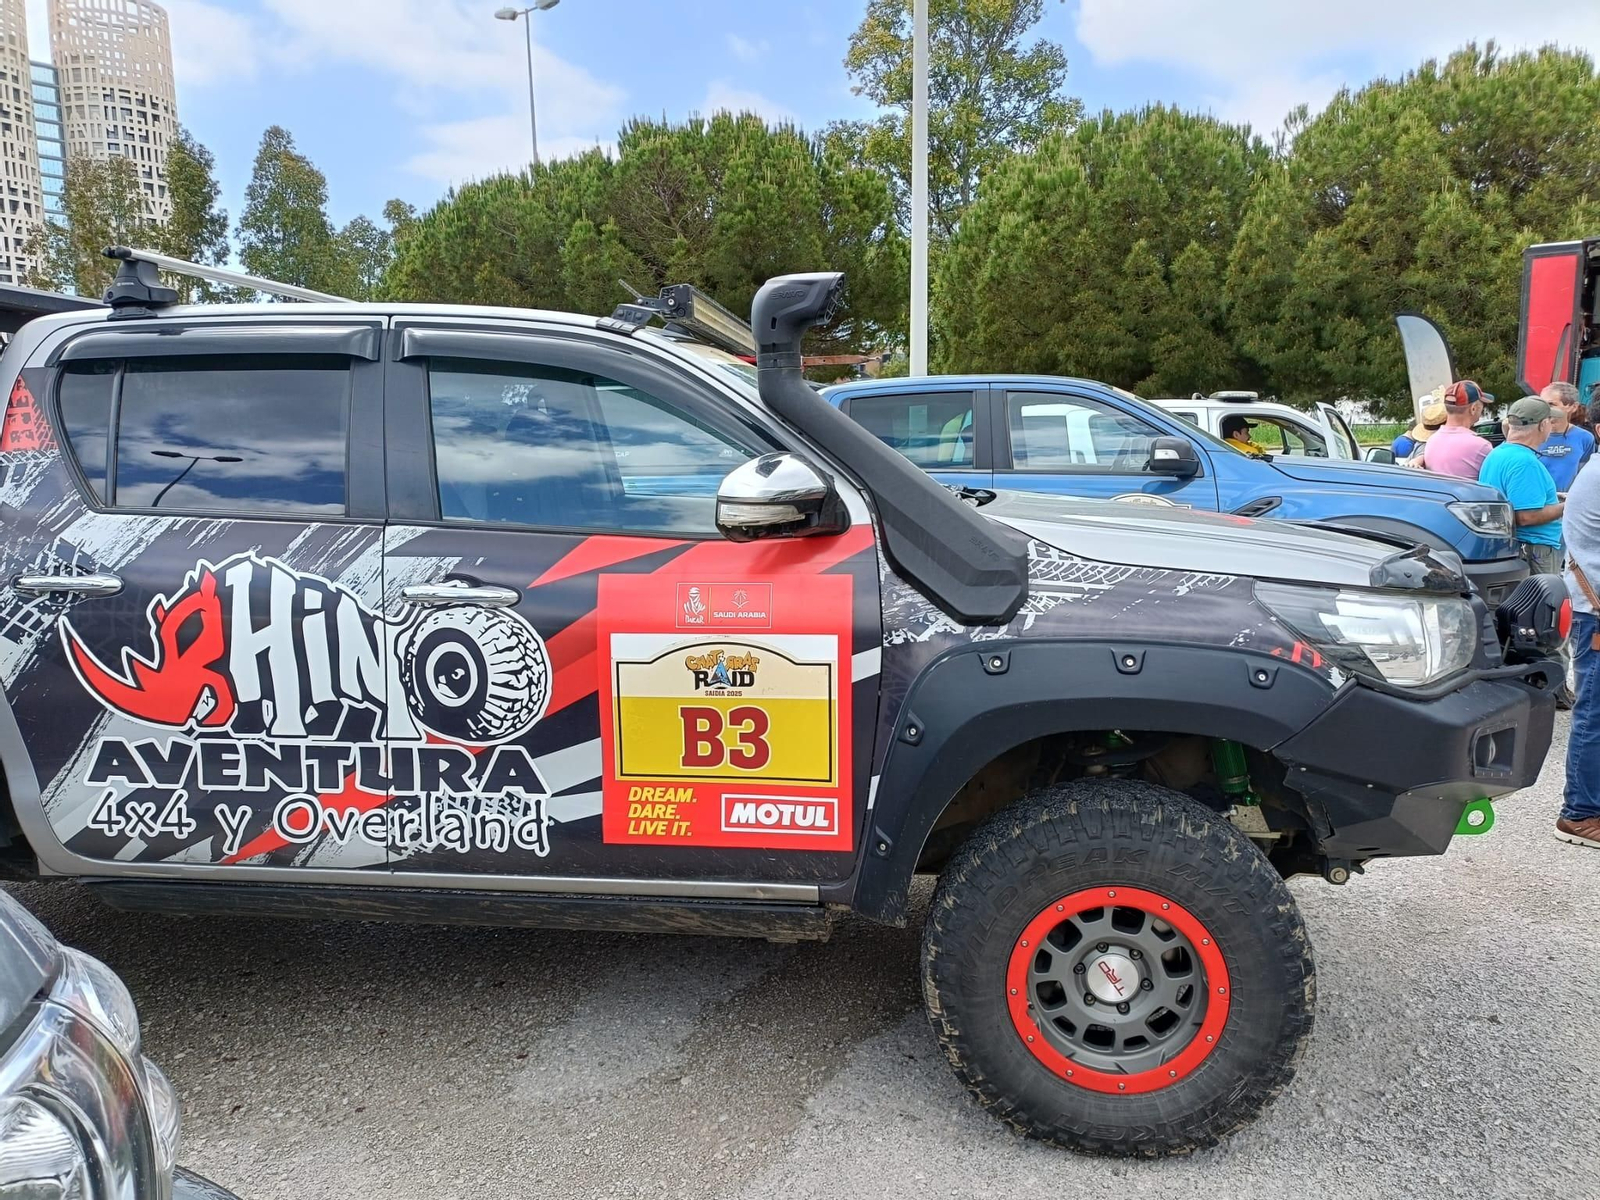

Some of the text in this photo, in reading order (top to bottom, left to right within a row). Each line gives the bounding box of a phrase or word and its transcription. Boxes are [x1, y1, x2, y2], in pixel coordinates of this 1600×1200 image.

[694, 670, 755, 690] RAID
[679, 705, 770, 771] B3
[85, 737, 549, 794] AVENTURA
[628, 786, 697, 804] DREAM.
[88, 787, 550, 857] 4x4 y Overland
[628, 804, 680, 820] DARE.
[729, 802, 829, 828] MOTUL
[628, 820, 692, 836] LIVE IT.
[1097, 961, 1124, 997] TRD
